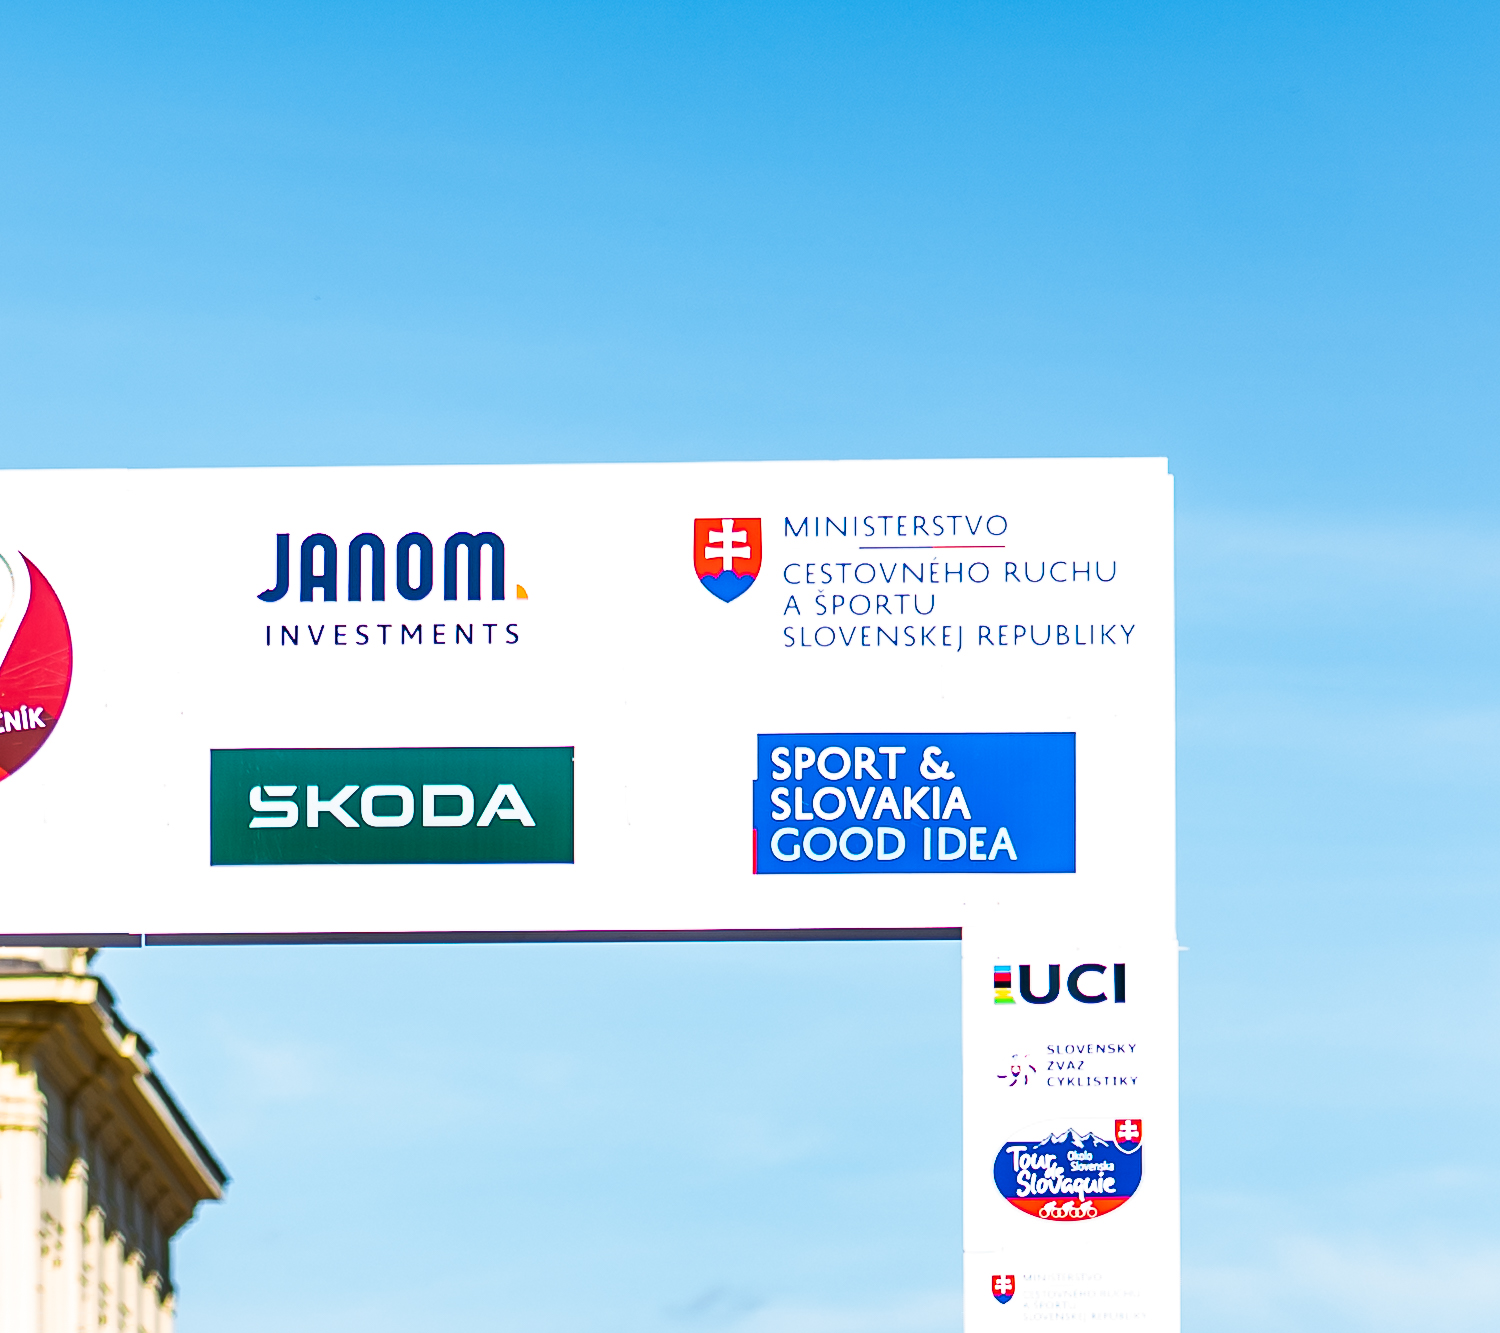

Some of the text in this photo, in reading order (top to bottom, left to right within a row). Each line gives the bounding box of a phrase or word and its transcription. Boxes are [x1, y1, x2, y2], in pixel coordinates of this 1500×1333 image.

[784, 514, 1008, 538] MINISTERSTVO
[783, 555, 1117, 585] CESTOVNÉHO RUCHU
[783, 588, 935, 616] A ŠPORTU
[266, 623, 519, 647] INVESTMENTS
[783, 624, 1136, 653] SLOVENSKEJ REPUBLIKY
[771, 746, 956, 781] SPORT &
[770, 786, 972, 821] SLOVAKIA
[770, 827, 1018, 862] GOOD IDEA
[1018, 962, 1126, 1005] UCI
[1046, 1076, 1138, 1087] CYKLISTIKY
[1006, 1146, 1056, 1172] Tour
[1016, 1169, 1117, 1202] Slovaquie
